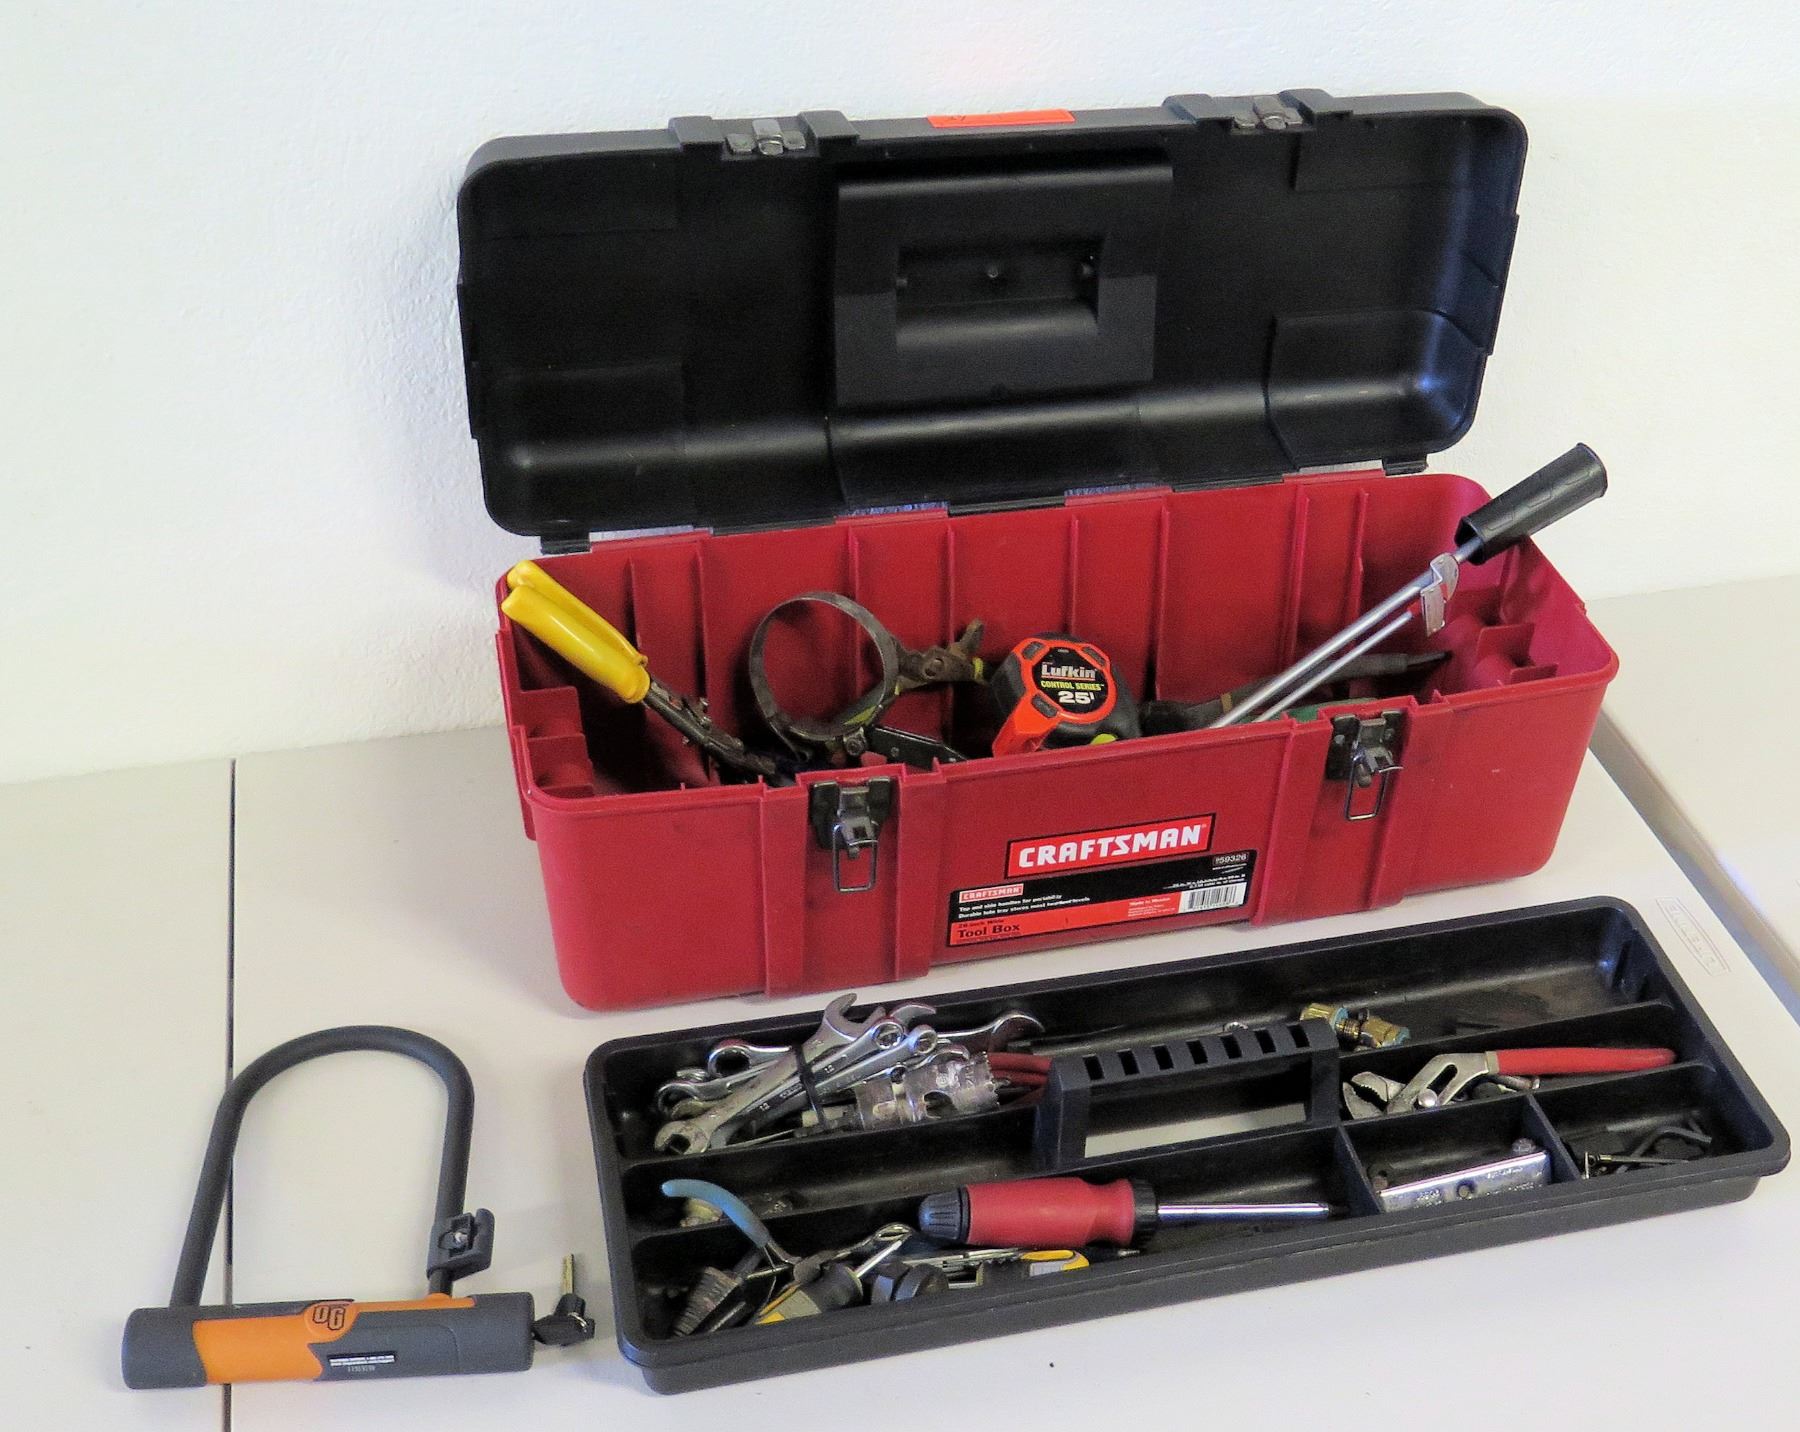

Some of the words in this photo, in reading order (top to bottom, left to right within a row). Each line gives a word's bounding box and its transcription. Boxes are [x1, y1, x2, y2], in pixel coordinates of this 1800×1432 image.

[1041, 664, 1096, 679] Lufkin
[1040, 680, 1075, 690] CONTROL
[1058, 690, 1095, 704] 25'
[1018, 824, 1201, 868] CRAFTSMAN
[962, 886, 1020, 900] CRAFTSMAN
[957, 926, 988, 938] Tool
[992, 923, 1020, 935] Box
